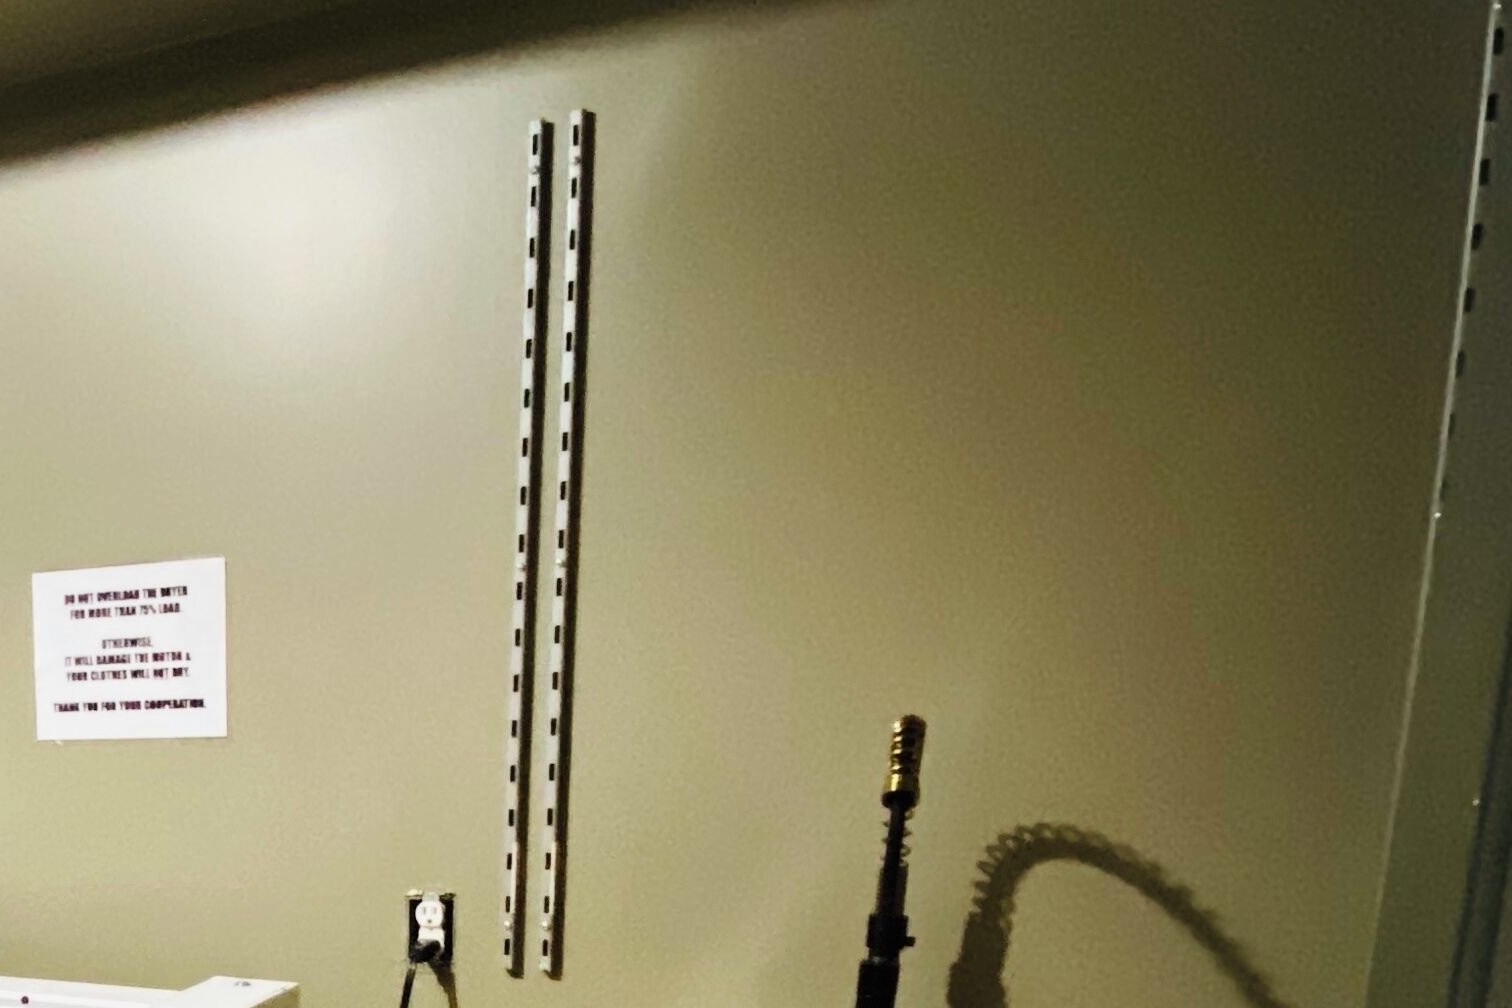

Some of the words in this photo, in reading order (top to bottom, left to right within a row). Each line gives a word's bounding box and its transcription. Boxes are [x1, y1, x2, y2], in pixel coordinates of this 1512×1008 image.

[78, 593, 93, 604] NOT
[97, 590, 139, 601] OVERLOAD
[143, 588, 156, 598] THE
[161, 586, 187, 597] DRYER
[70, 609, 85, 620] FOR
[88, 607, 111, 618] MORE
[115, 605, 136, 617] THAN
[75, 655, 93, 666] WILL
[96, 654, 130, 665] DAMAGE
[135, 653, 149, 664] THE
[152, 652, 181, 661] MOTOR
[67, 671, 88, 682] YOUR
[91, 670, 127, 680] CLOTHES
[131, 669, 150, 680] WILL
[153, 668, 169, 679] NOT
[54, 702, 80, 713] THANK
[83, 701, 98, 712] YOU
[101, 701, 116, 711] FOR
[120, 700, 141, 711] YOUR
